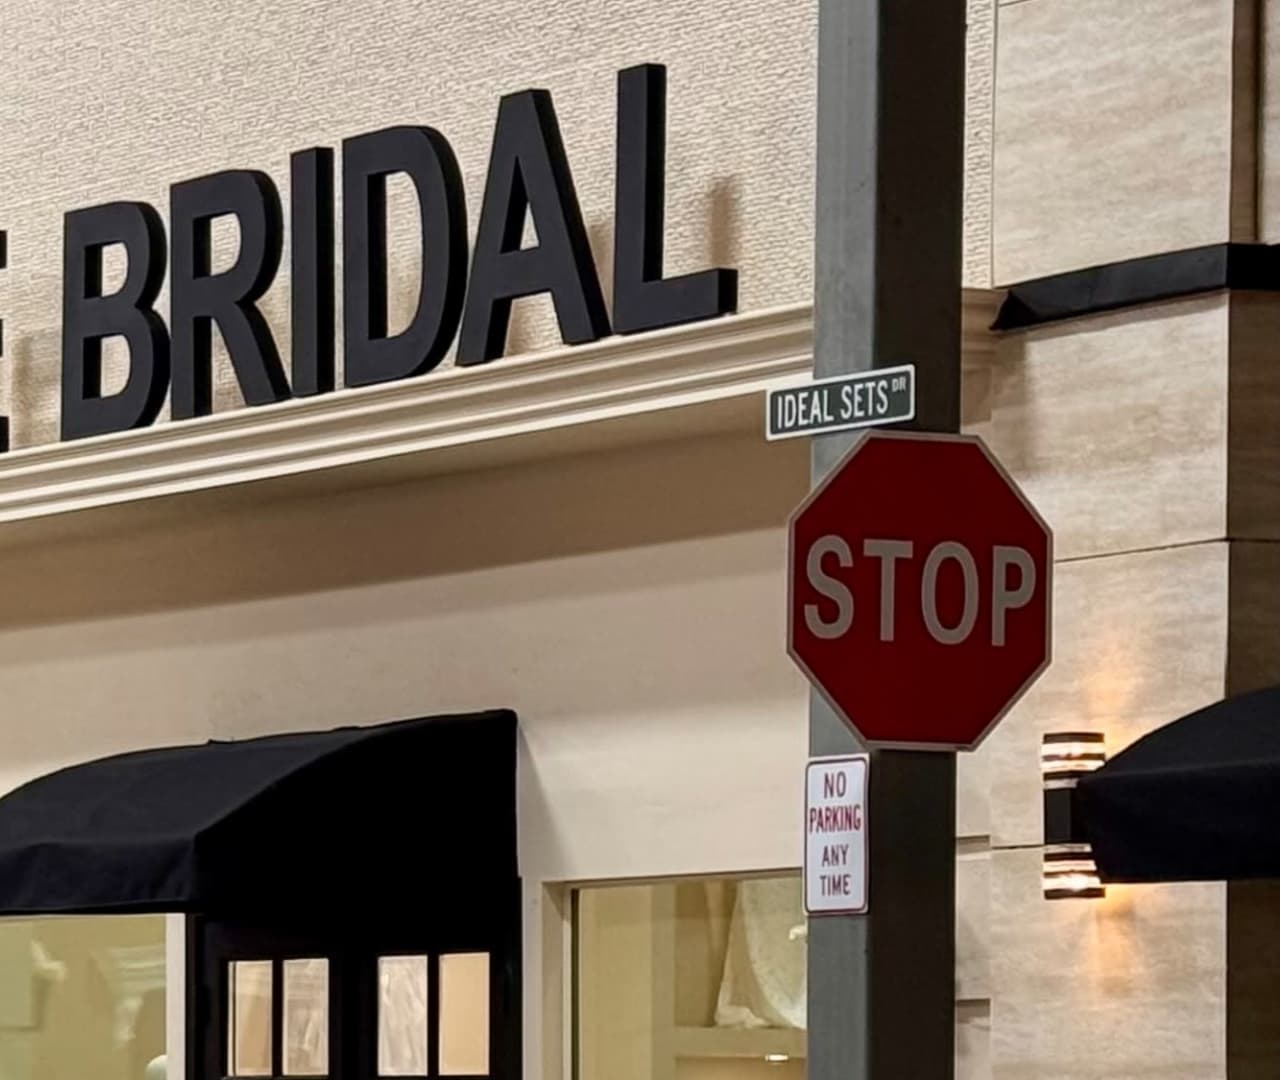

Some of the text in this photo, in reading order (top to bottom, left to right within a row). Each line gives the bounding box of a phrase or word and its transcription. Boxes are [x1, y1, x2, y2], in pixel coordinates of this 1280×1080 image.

[61, 63, 738, 441] BRIDAL
[777, 376, 907, 429] IDEAL SETS DR
[804, 534, 1037, 647] STOP
[823, 771, 847, 799] NO
[809, 804, 862, 834] PARKING
[821, 843, 850, 867] ANY
[819, 874, 852, 897] TIME
